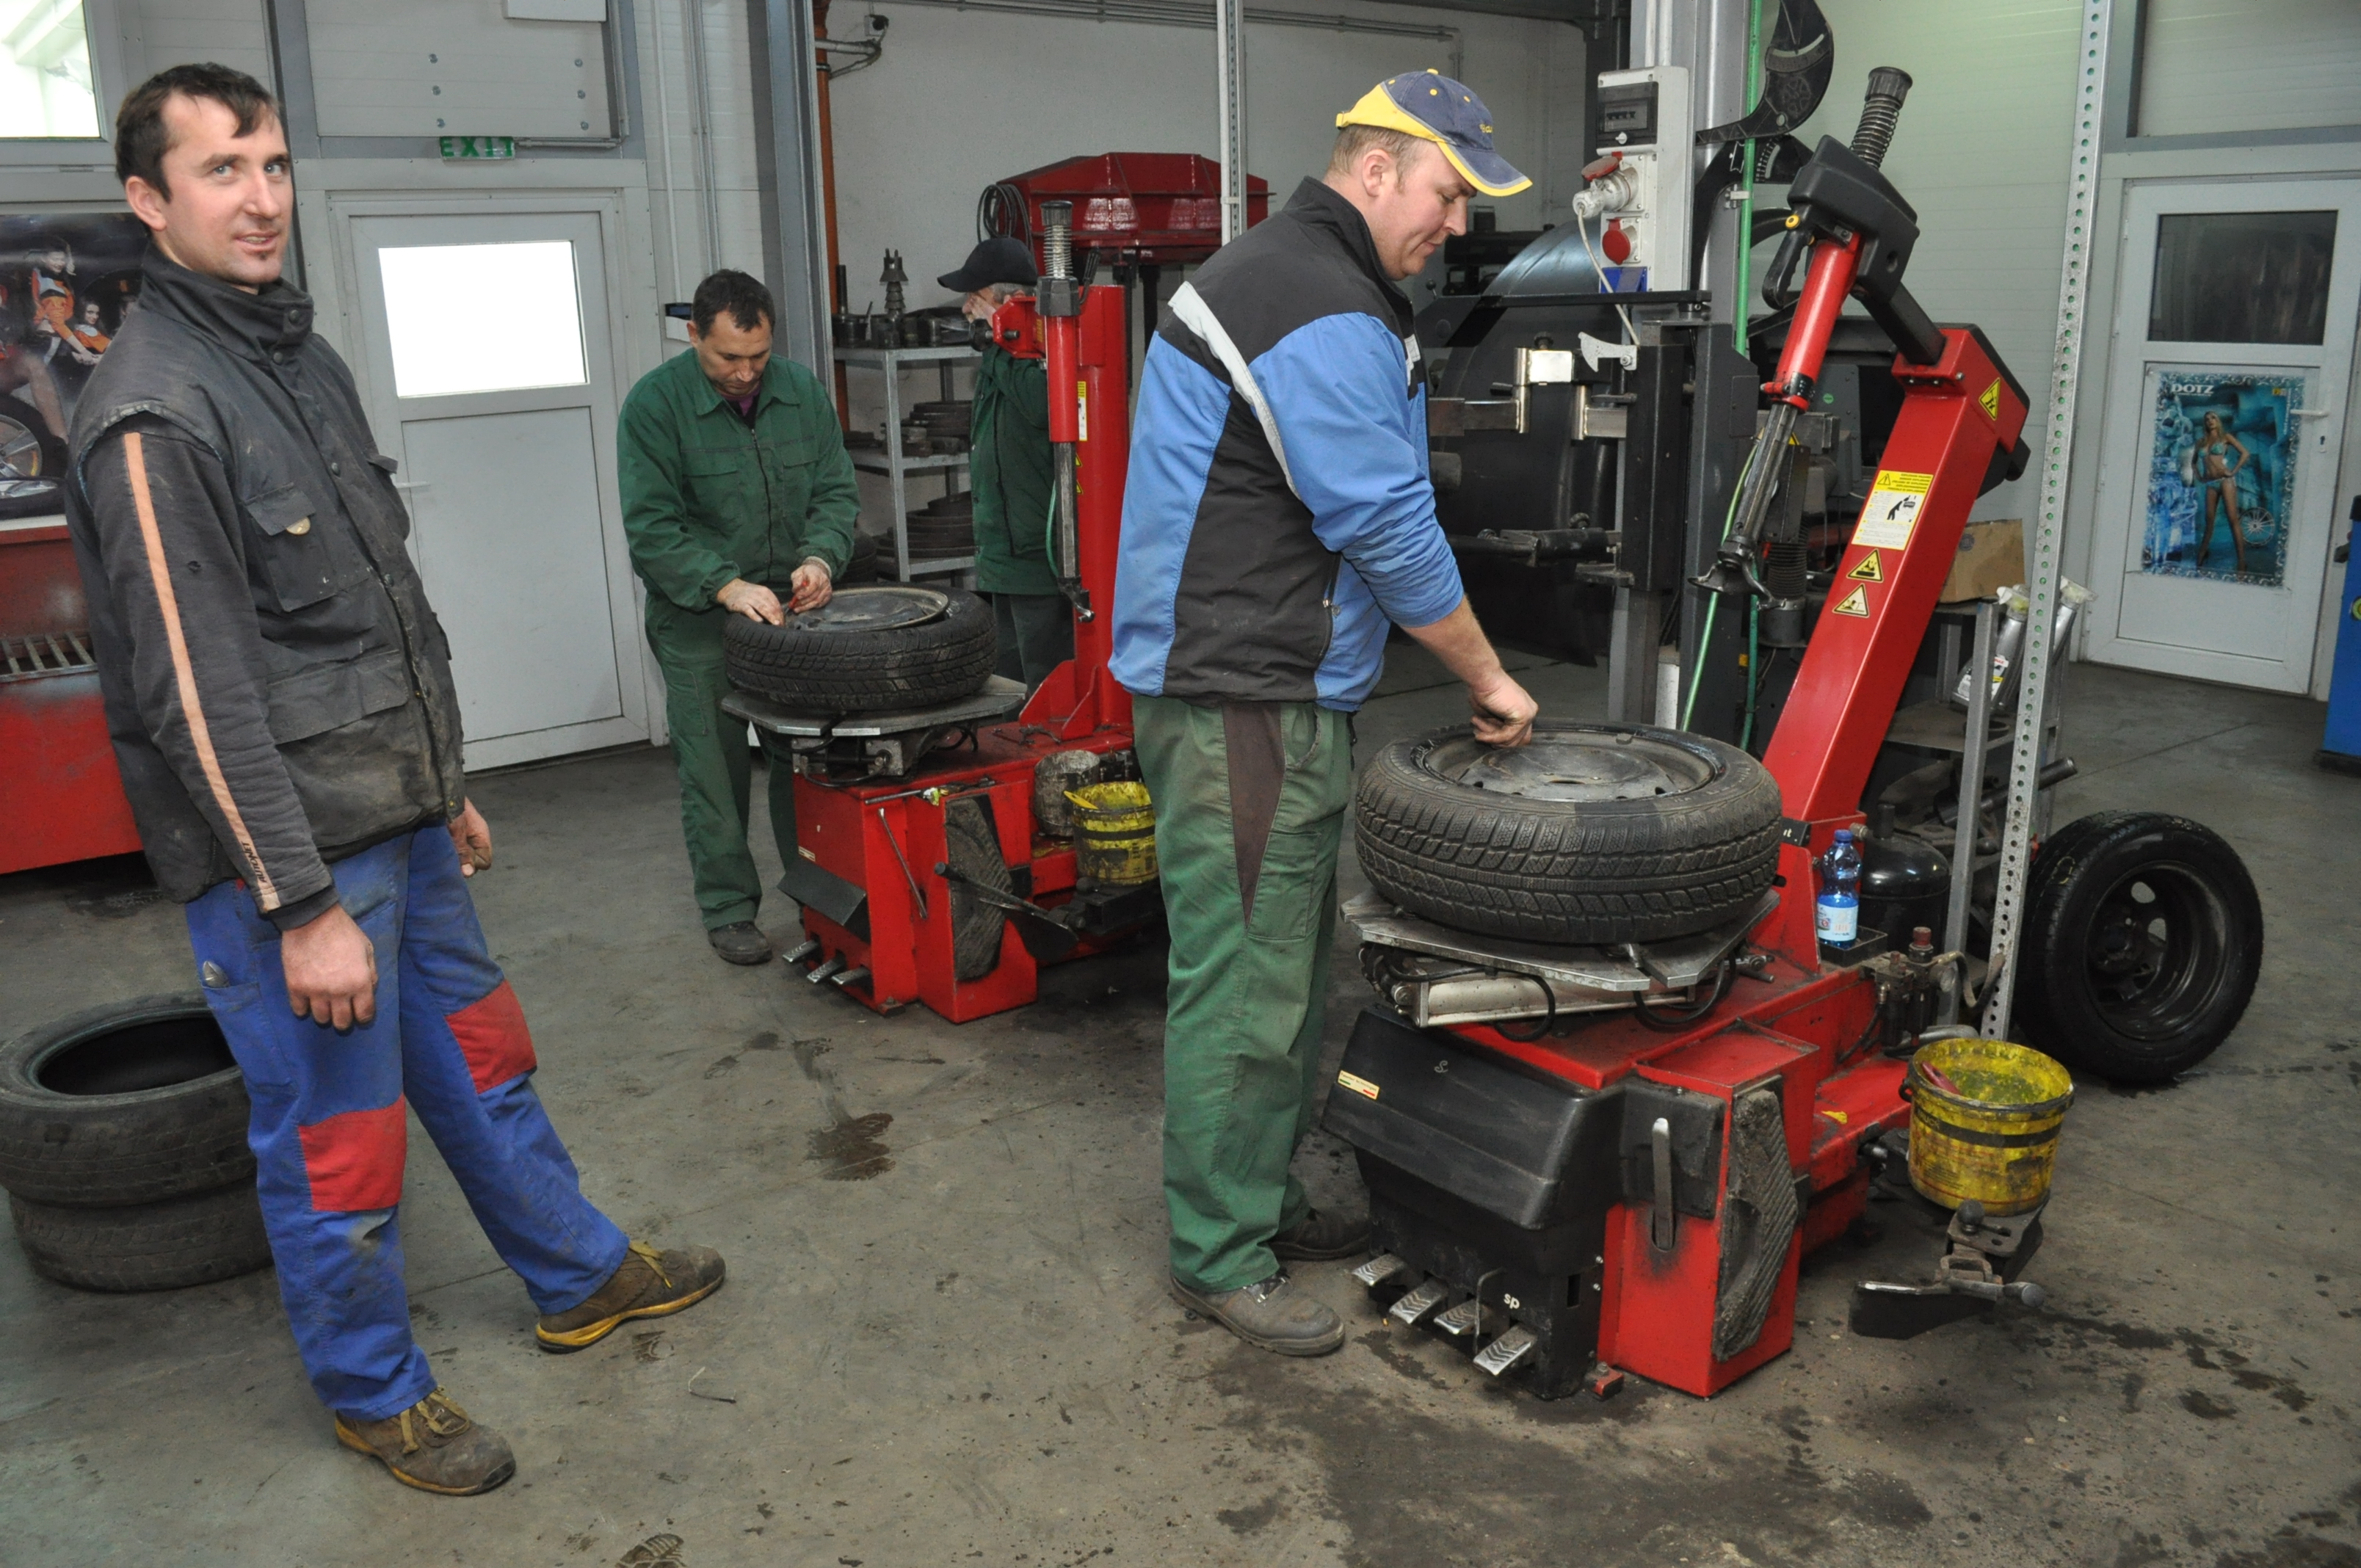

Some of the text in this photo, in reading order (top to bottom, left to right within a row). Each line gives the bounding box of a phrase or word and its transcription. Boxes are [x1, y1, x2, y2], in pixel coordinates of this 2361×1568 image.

[440, 136, 513, 157] EXIT
[2172, 383, 2214, 394] DOTZ
[241, 841, 267, 883] AUTONET
[1504, 1293, 1520, 1309] sp
